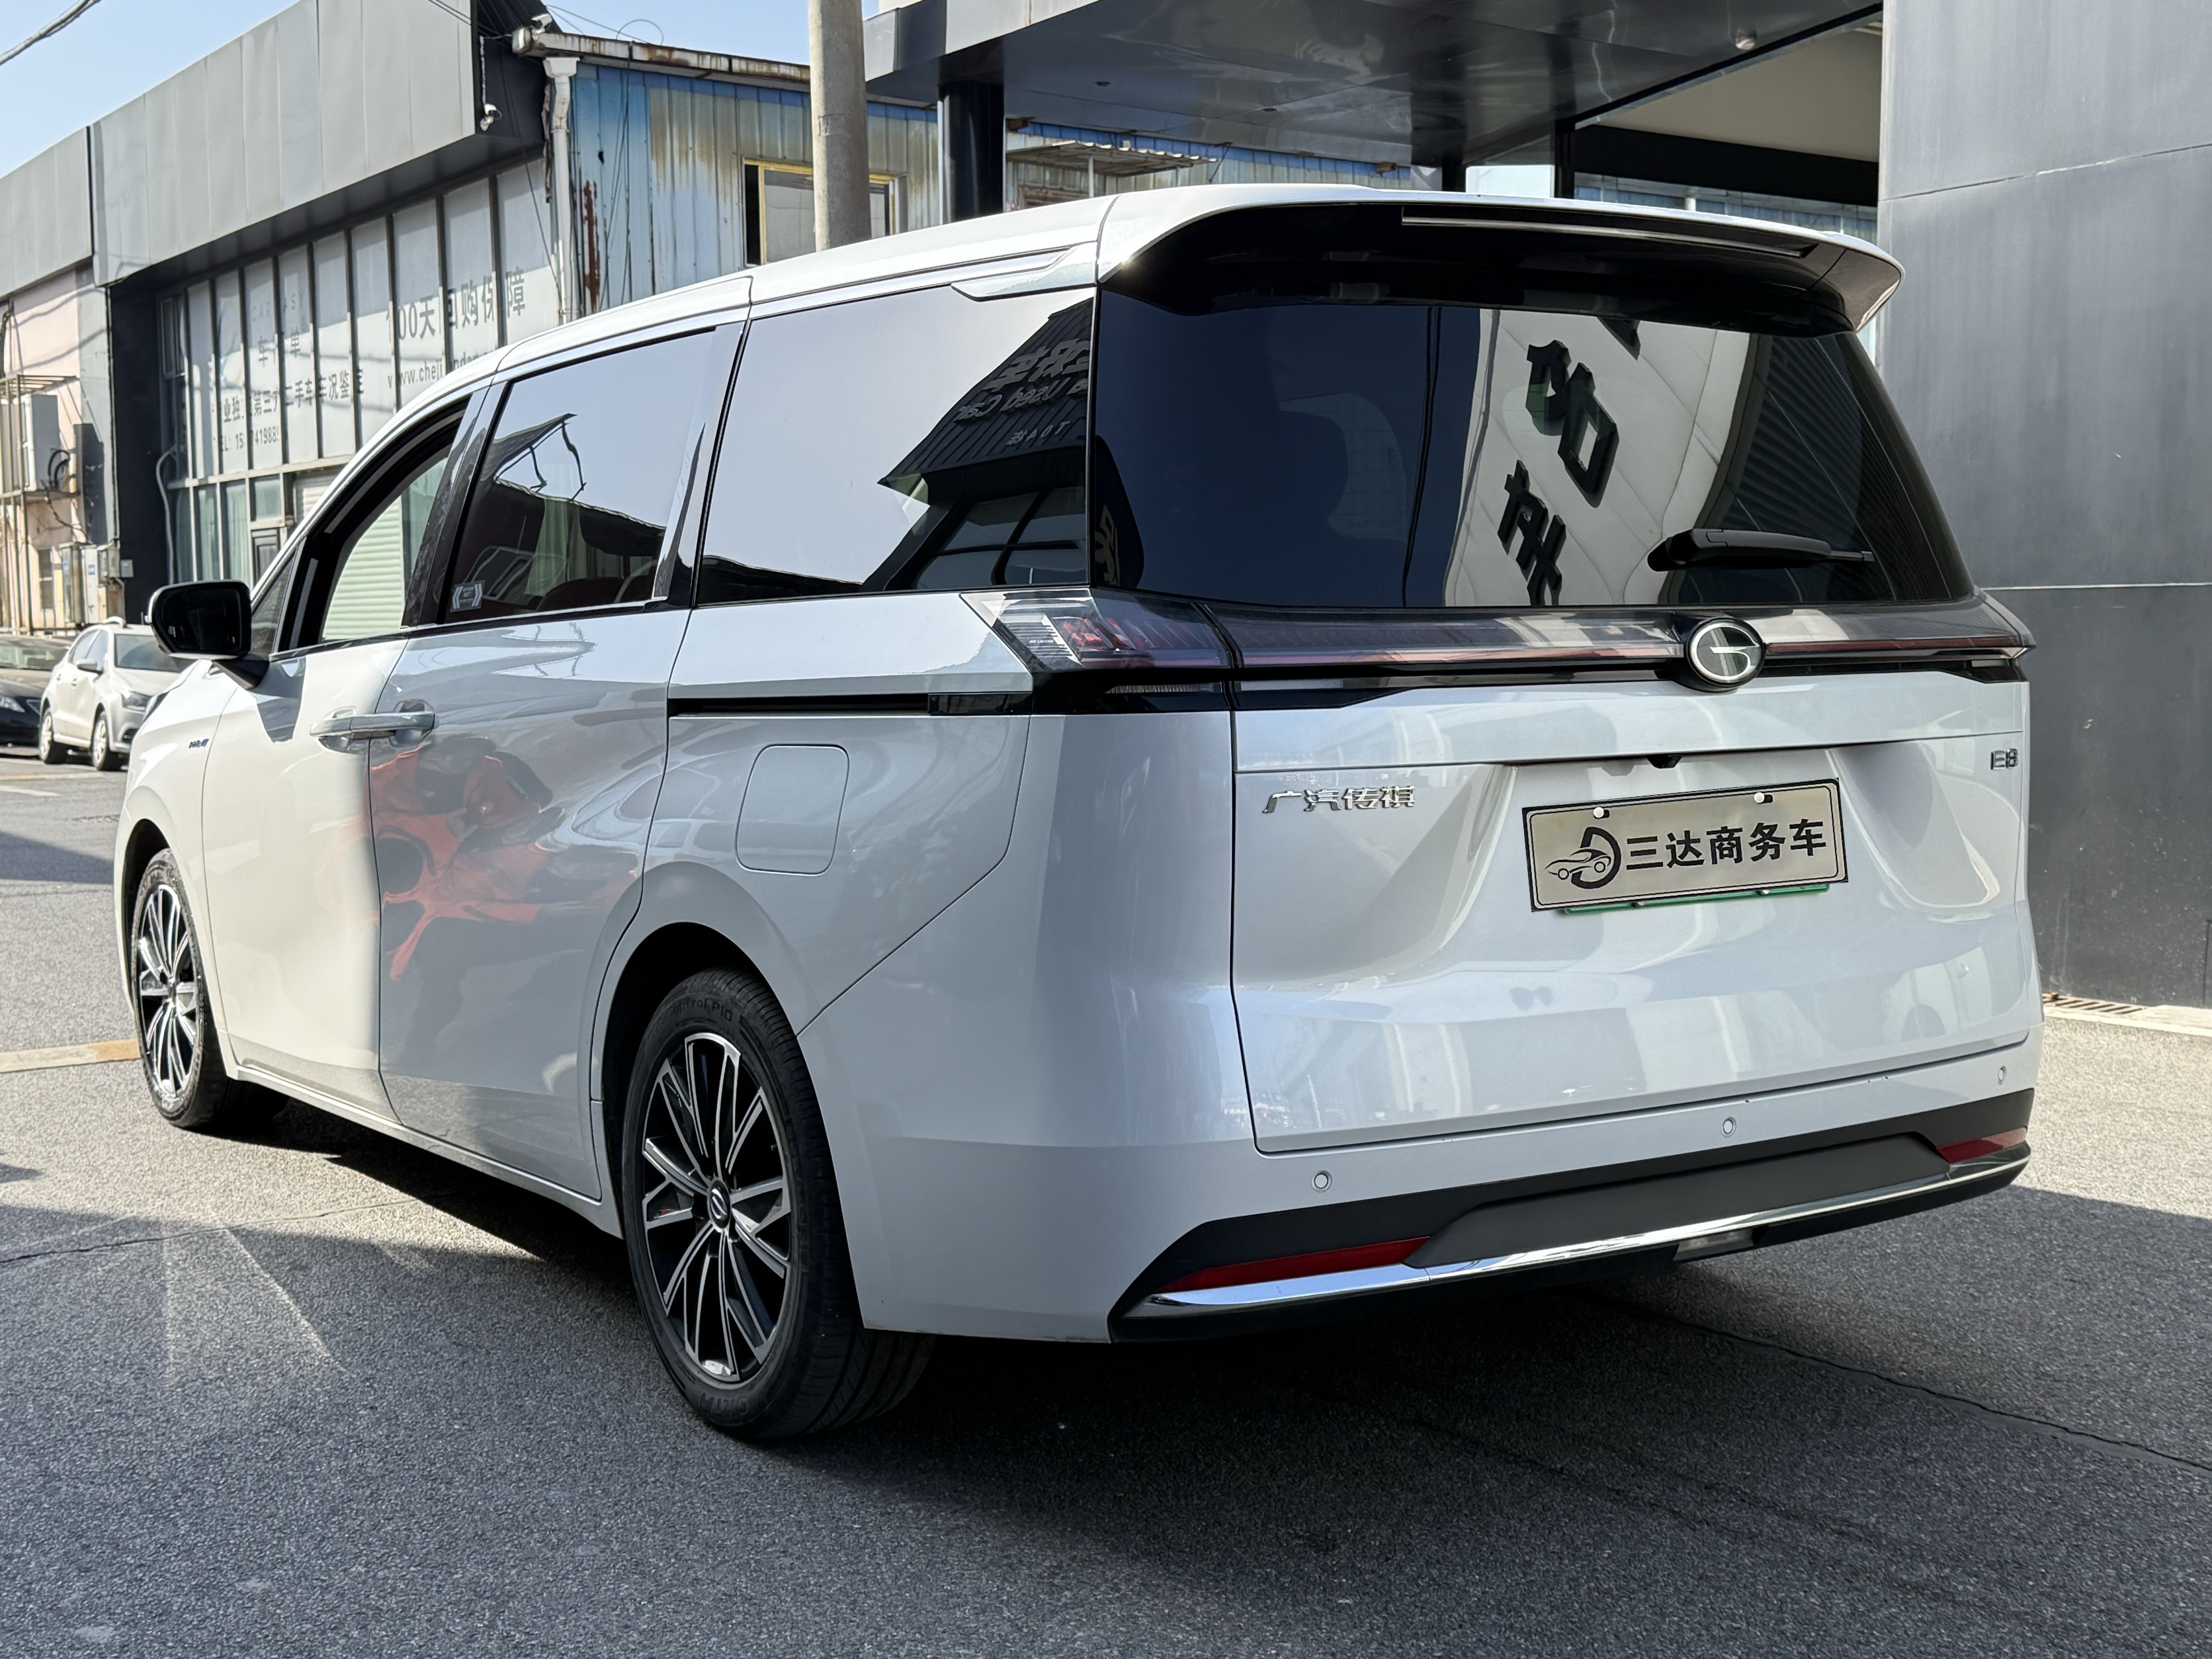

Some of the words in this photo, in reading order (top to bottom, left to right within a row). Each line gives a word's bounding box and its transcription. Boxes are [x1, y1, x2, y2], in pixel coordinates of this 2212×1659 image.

[257, 326, 301, 368] 车单
[1990, 748, 2019, 770] E8
[1261, 785, 1416, 814] 广汽传祺
[1626, 818, 1827, 871] 三达商务车
